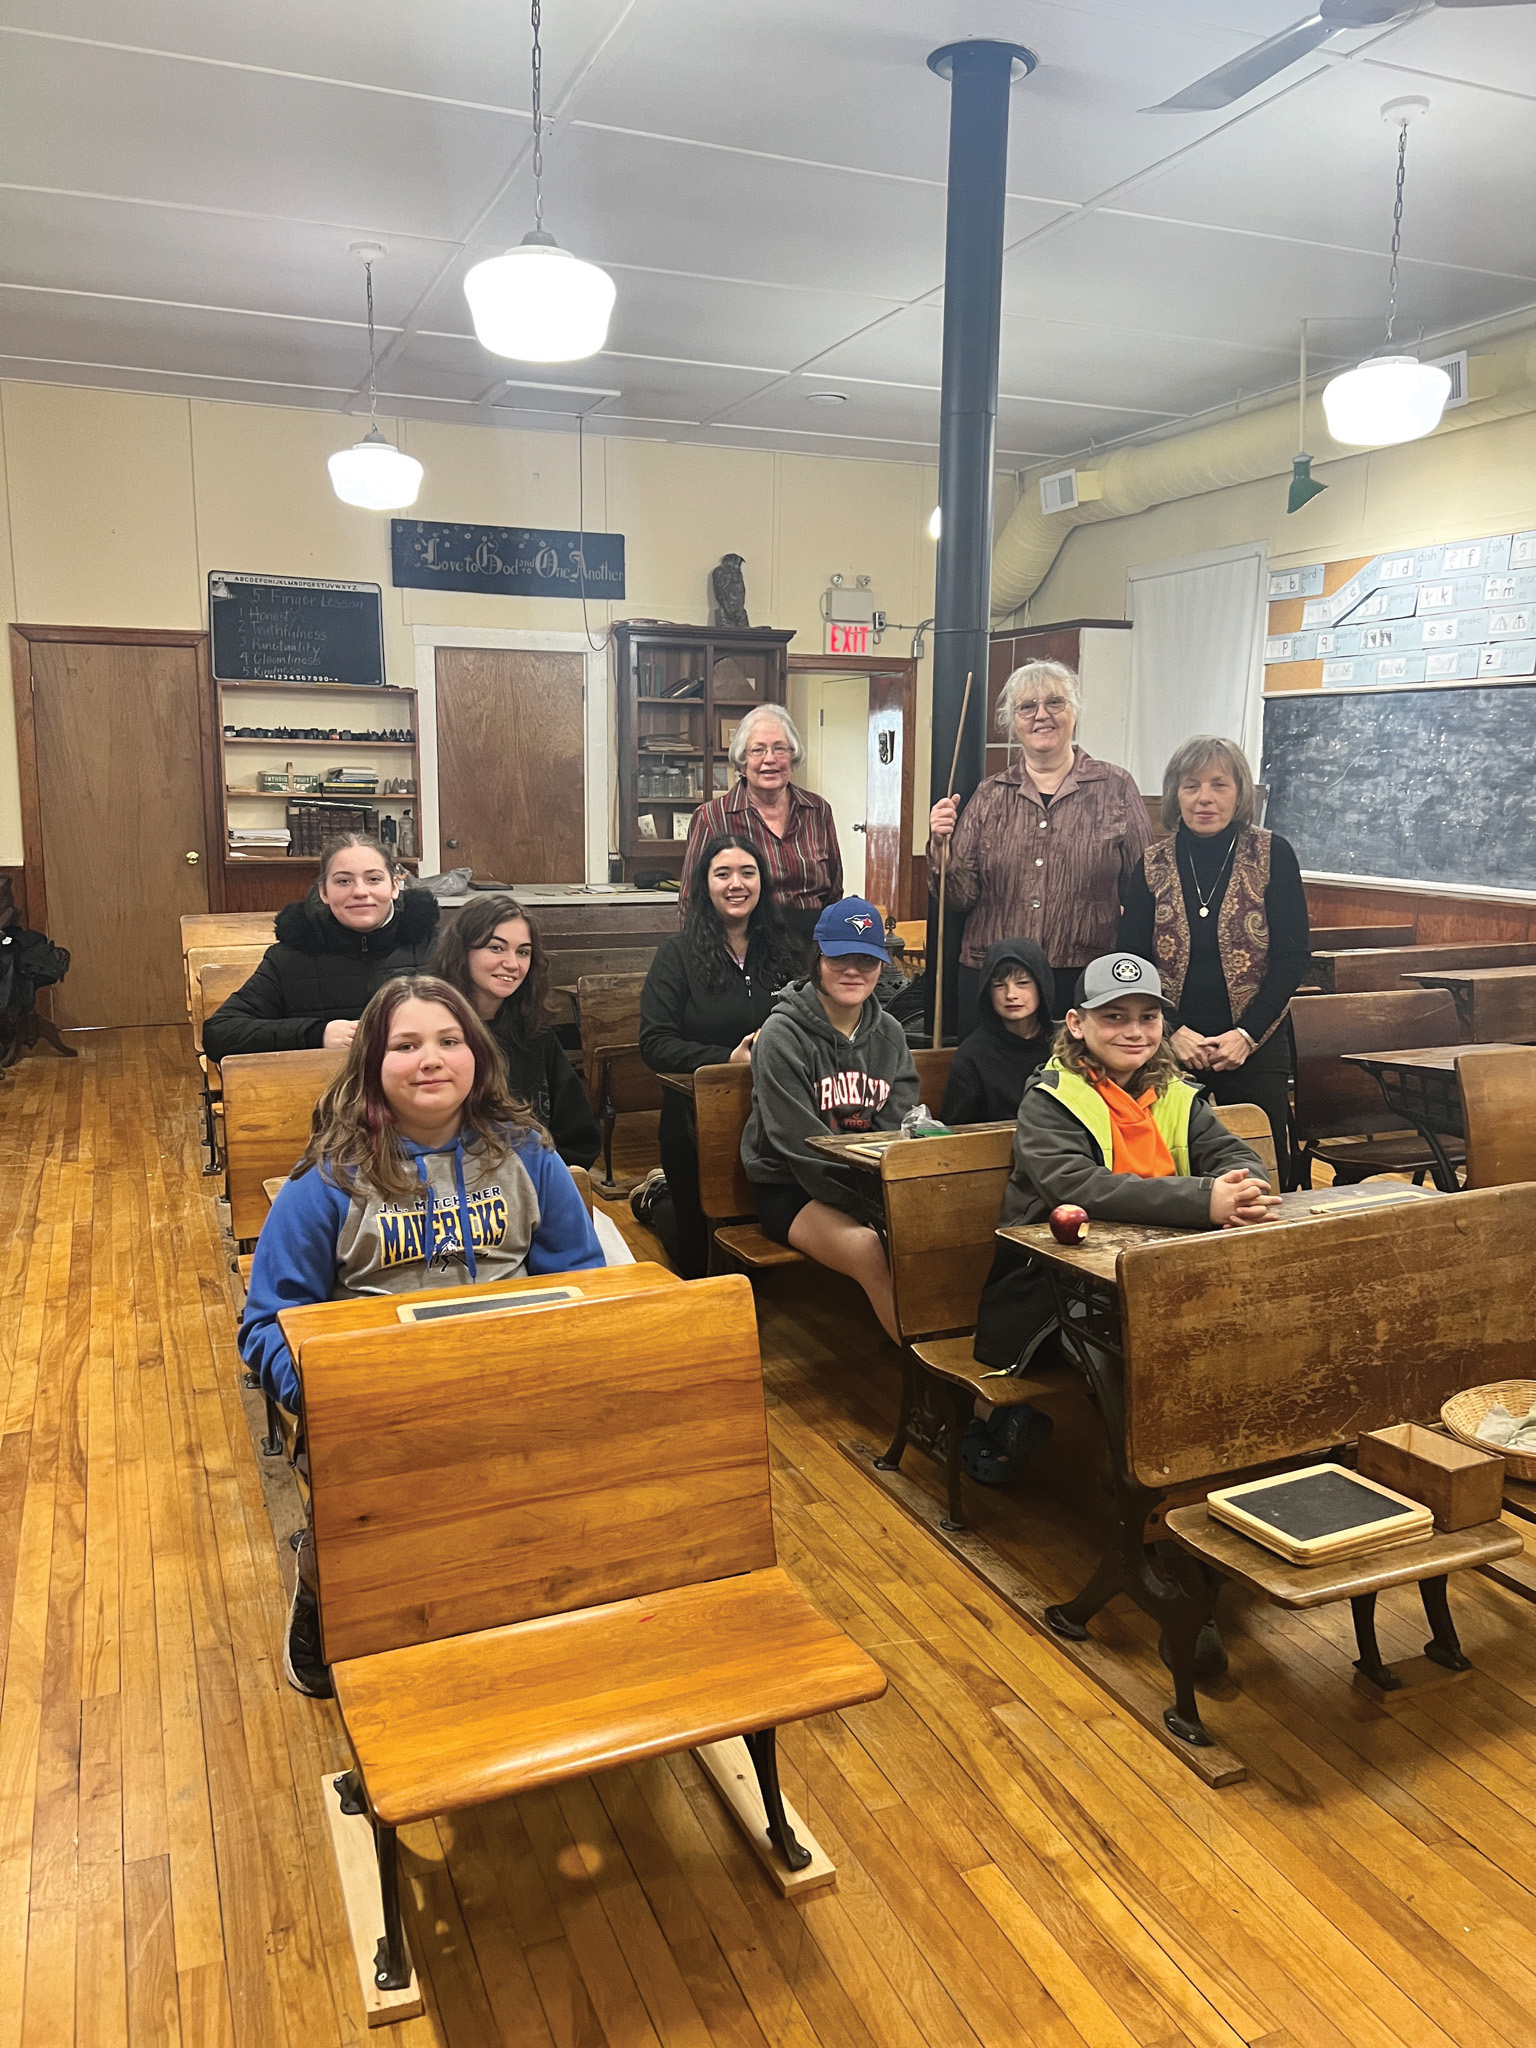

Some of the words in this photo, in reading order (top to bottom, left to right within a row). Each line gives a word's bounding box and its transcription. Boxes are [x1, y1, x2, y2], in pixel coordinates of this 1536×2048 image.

[420, 537, 466, 571] Love
[464, 554, 479, 573] to
[475, 540, 519, 575] God
[534, 547, 570, 579] One
[569, 550, 624, 583] Another
[1301, 568, 1317, 580] bird
[271, 588, 316, 614] Finger
[250, 621, 327, 641] Truthfulness
[830, 625, 869, 653] EXIT
[252, 637, 320, 662] Punctuality
[814, 1071, 890, 1112] ROOKLYN
[414, 1186, 501, 1211] MTCHENER
